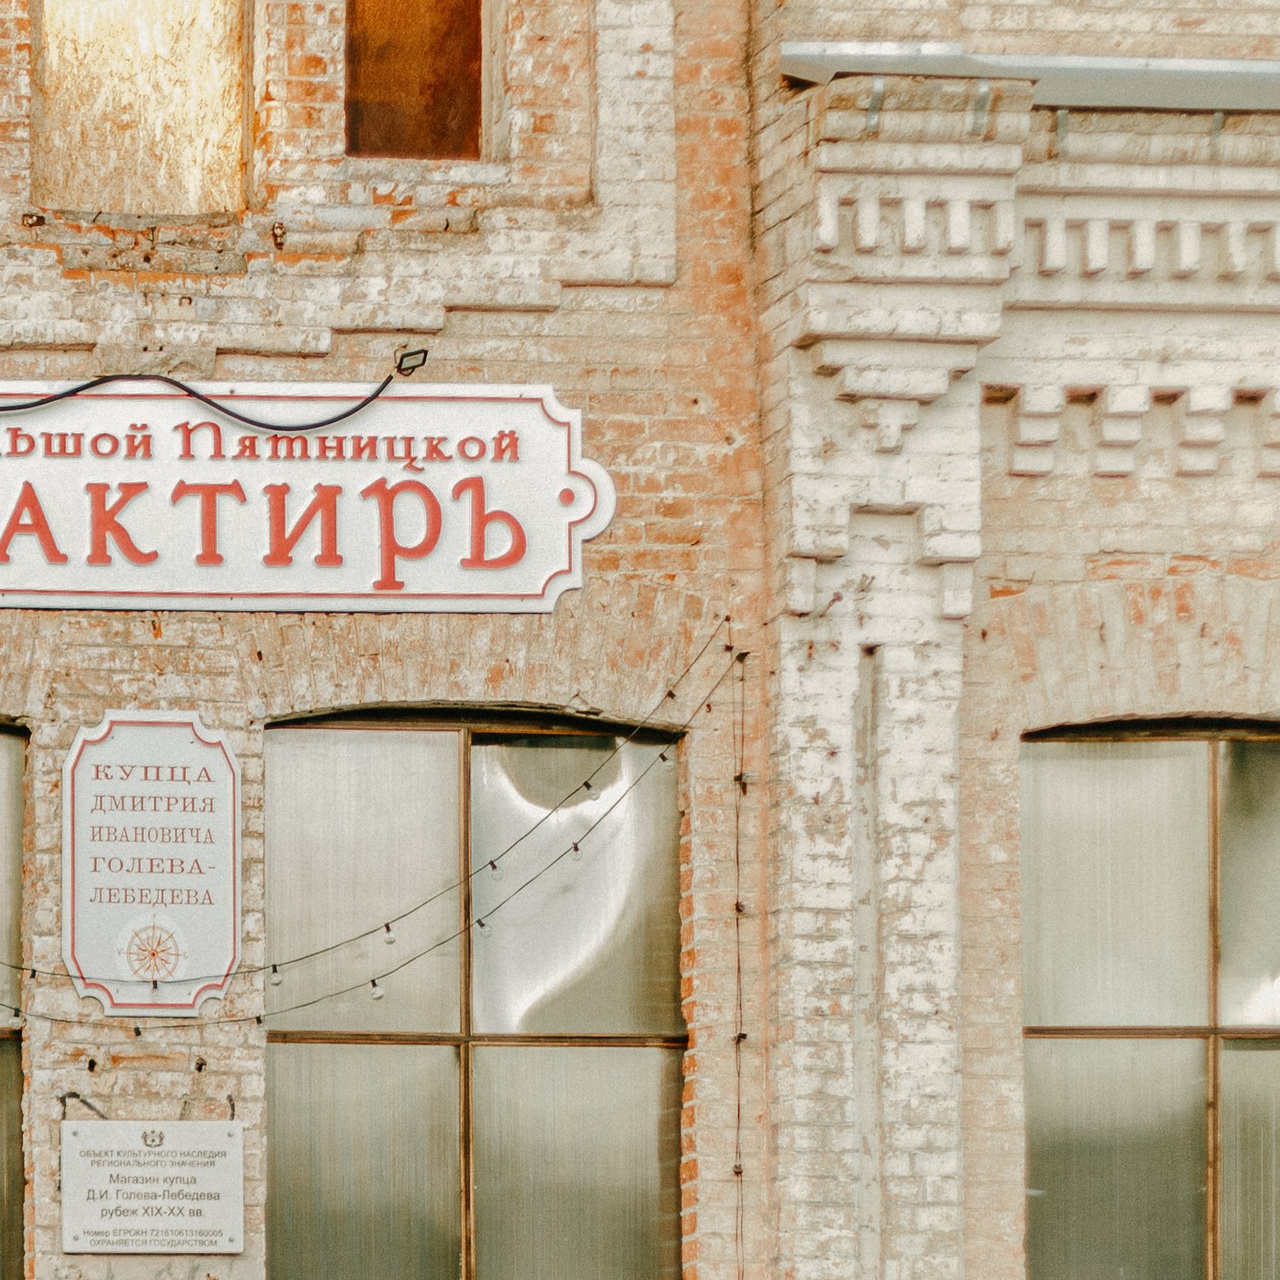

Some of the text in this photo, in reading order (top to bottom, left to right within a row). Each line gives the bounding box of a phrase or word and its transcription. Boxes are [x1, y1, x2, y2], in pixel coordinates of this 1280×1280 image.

[173, 420, 521, 472] Пятницкой
[90, 764, 216, 785] КУПЦА
[90, 794, 216, 814] ДМИТРИЯ
[89, 825, 216, 844] ИВАНОВИЧА
[89, 856, 217, 875] ГОЛЕВА-
[89, 887, 216, 908] ЛЕБЕДЕВА
[79, 1150, 227, 1159] ОБЪЕКТ КУЛЬТУРНОГО НАСЛЕДИЯ
[90, 1160, 216, 1168] РЕГИОНАЛЬНОГО ЗНАЧЕНИЯ
[109, 1173, 197, 1187] Магазин купца
[86, 1189, 221, 1201] Д.И. Голева-Лебедева
[101, 1206, 206, 1219] рубеж XIX-XX вв.
[83, 1229, 111, 1238] Номер
[112, 1229, 148, 1237] ЕГРОКН
[89, 1239, 218, 1247] ОХРАНЯЕТСЯ ГОСУДАРСТВОМ
